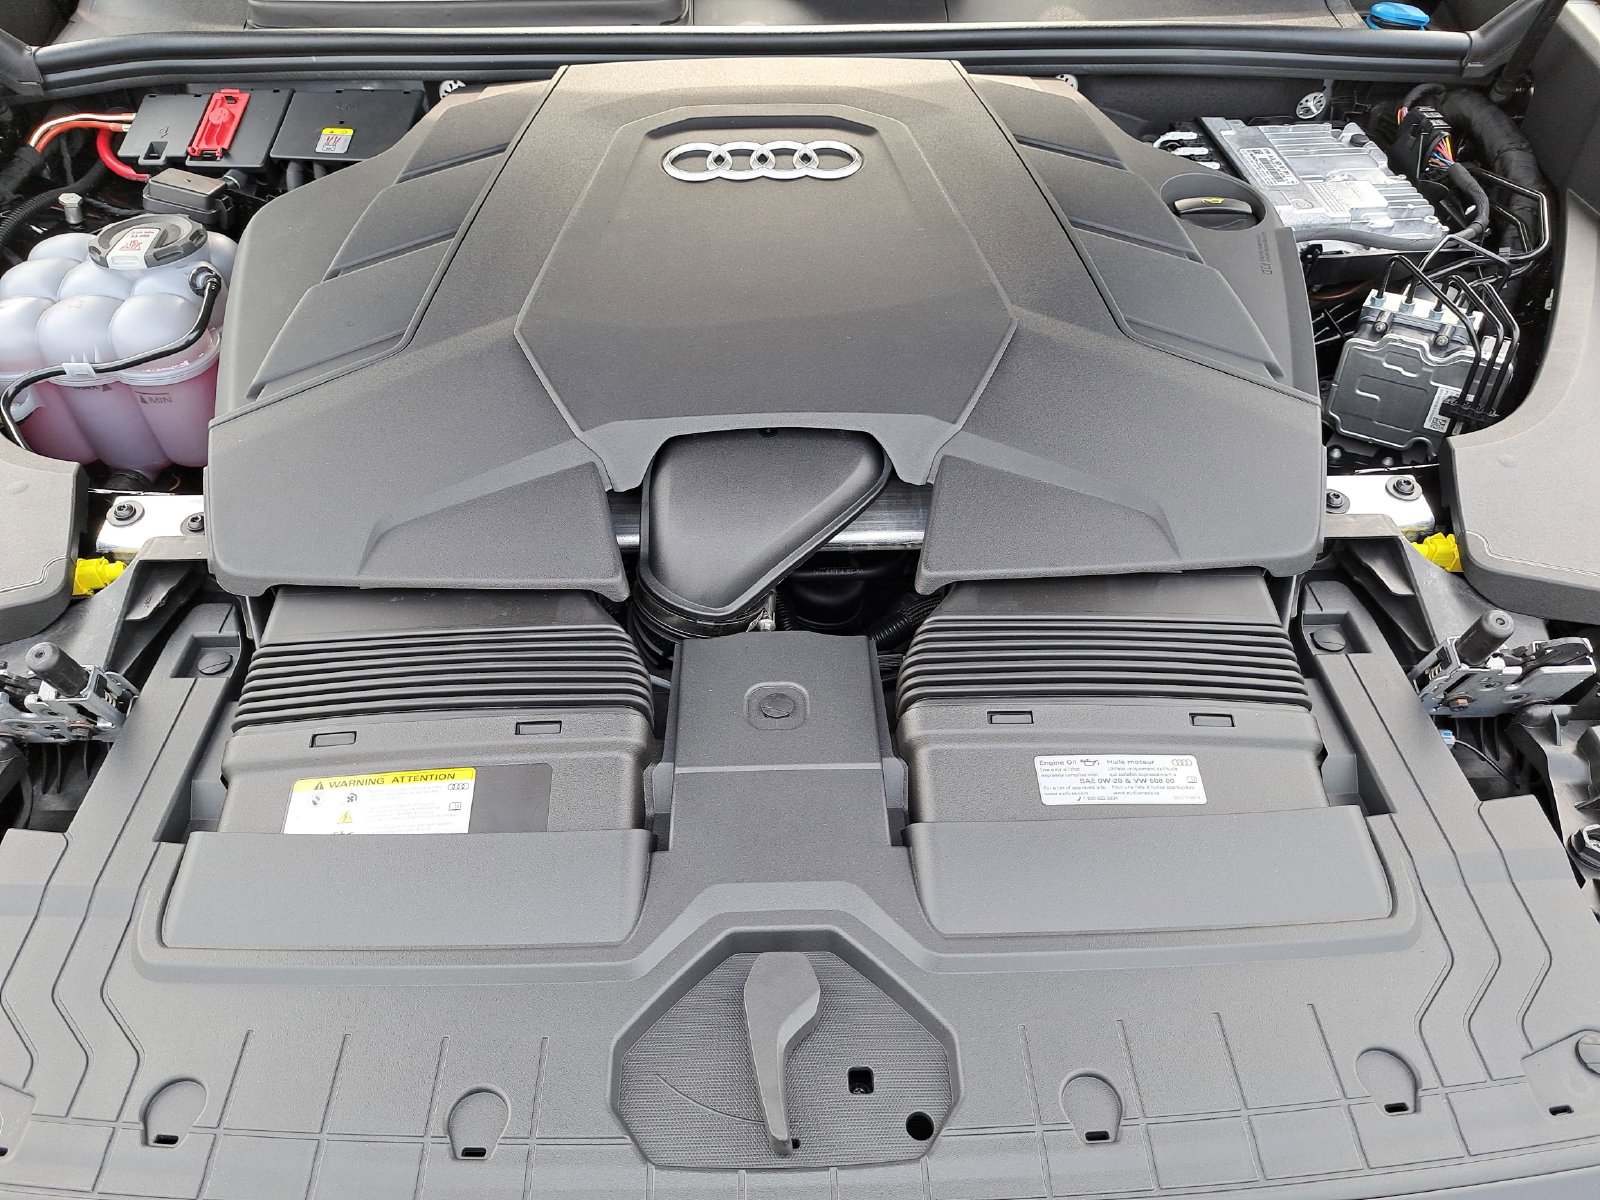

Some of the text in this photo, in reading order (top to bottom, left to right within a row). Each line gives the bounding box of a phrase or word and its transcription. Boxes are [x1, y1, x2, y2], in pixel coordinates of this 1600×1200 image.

[148, 396, 173, 404] MIN
[329, 772, 456, 789] WARNING ATTENTION
